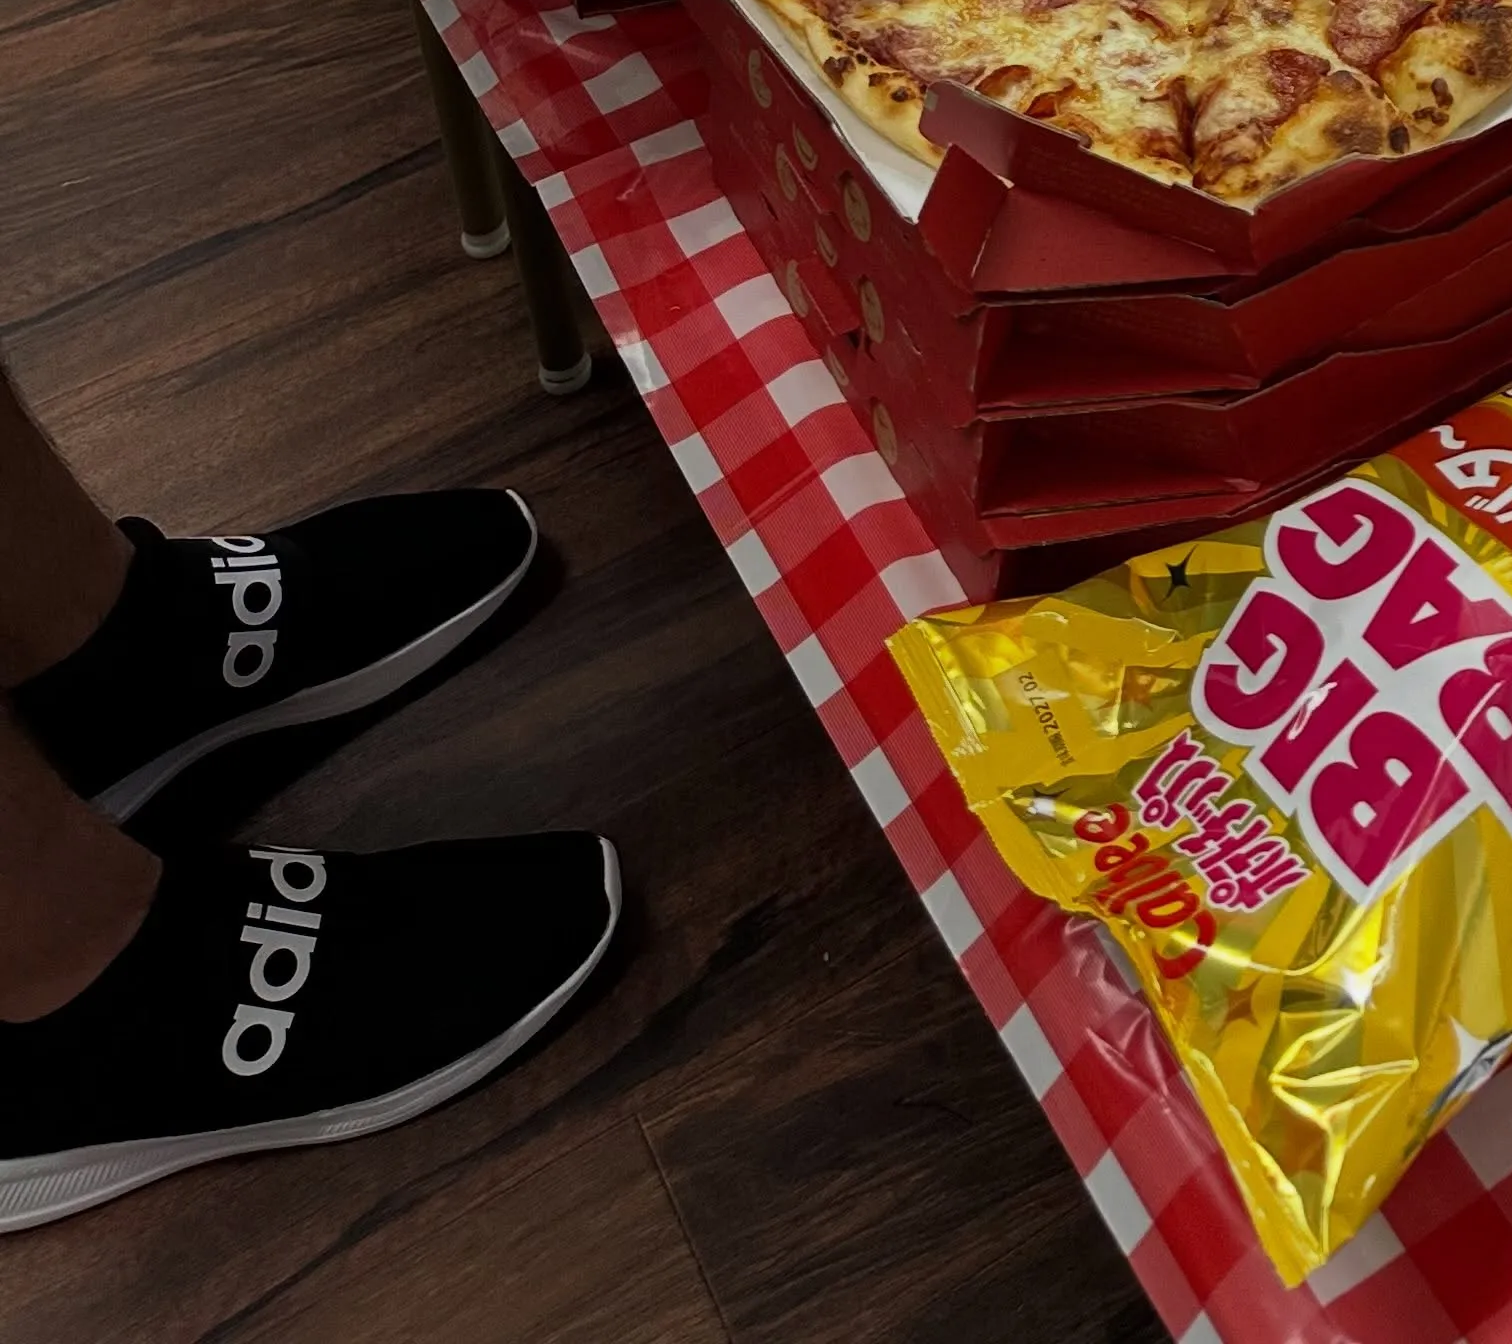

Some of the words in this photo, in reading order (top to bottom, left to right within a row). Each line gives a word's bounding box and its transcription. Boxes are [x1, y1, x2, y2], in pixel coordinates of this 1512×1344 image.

[1133, 732, 1312, 912] ポテトチップス
[1200, 587, 1473, 889] BIG
[222, 844, 327, 1077] adid
[1072, 802, 1218, 981] Calbee
